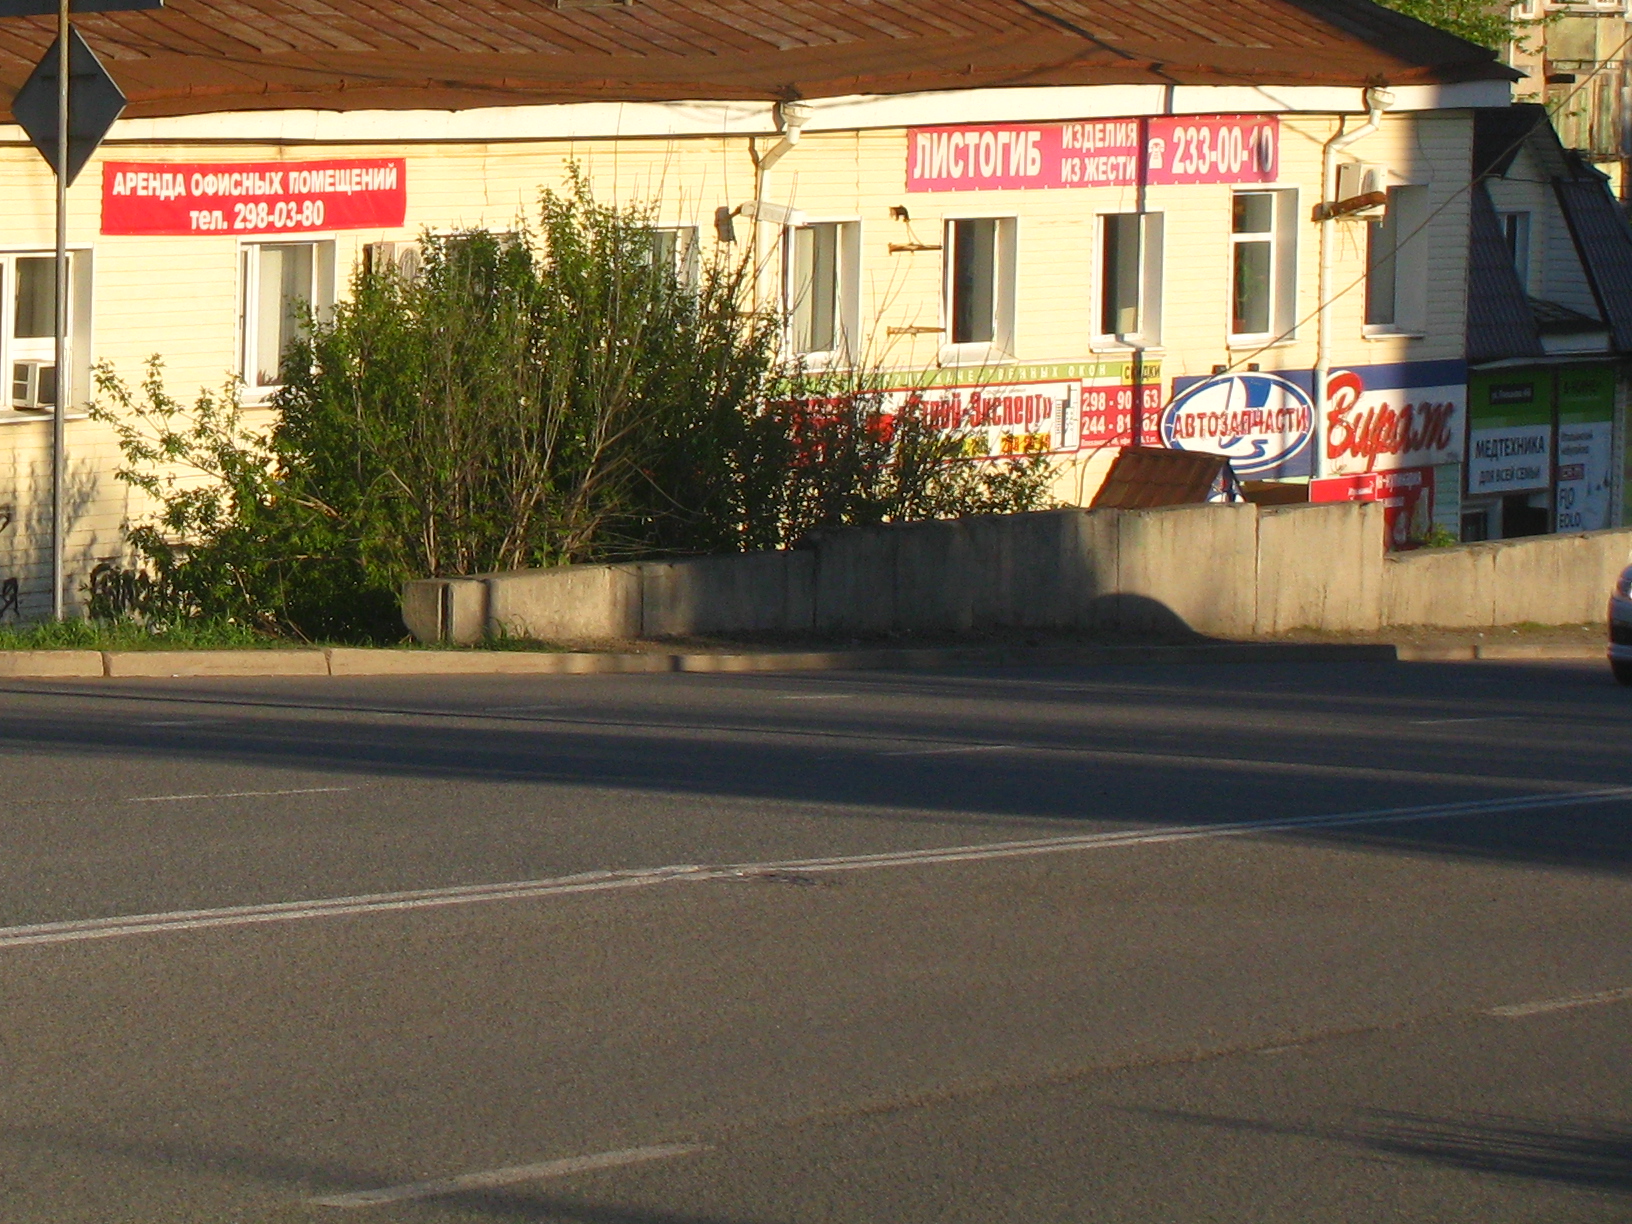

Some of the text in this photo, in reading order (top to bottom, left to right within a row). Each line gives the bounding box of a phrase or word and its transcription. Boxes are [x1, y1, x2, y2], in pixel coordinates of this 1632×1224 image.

[913, 122, 1274, 180] ЛИСТОГИБ ИЗДЕЛИЯ 233-00-10
[112, 162, 398, 201] АРЕНДА ОФИСНЫХ ПОМЕЩЕНИЙ
[1061, 155, 1137, 184] ИЗ ЖЕСТИ
[189, 199, 325, 231] тел. 298-03-80
[1171, 405, 1309, 440] АВТОЗАПЧАСТИ
[1326, 370, 1456, 475] Вираж
[1475, 435, 1546, 462] МЕДТЕХНИКА
[1478, 470, 1494, 486] ДЛЯ
[1496, 465, 1518, 482] ВСЕЙ
